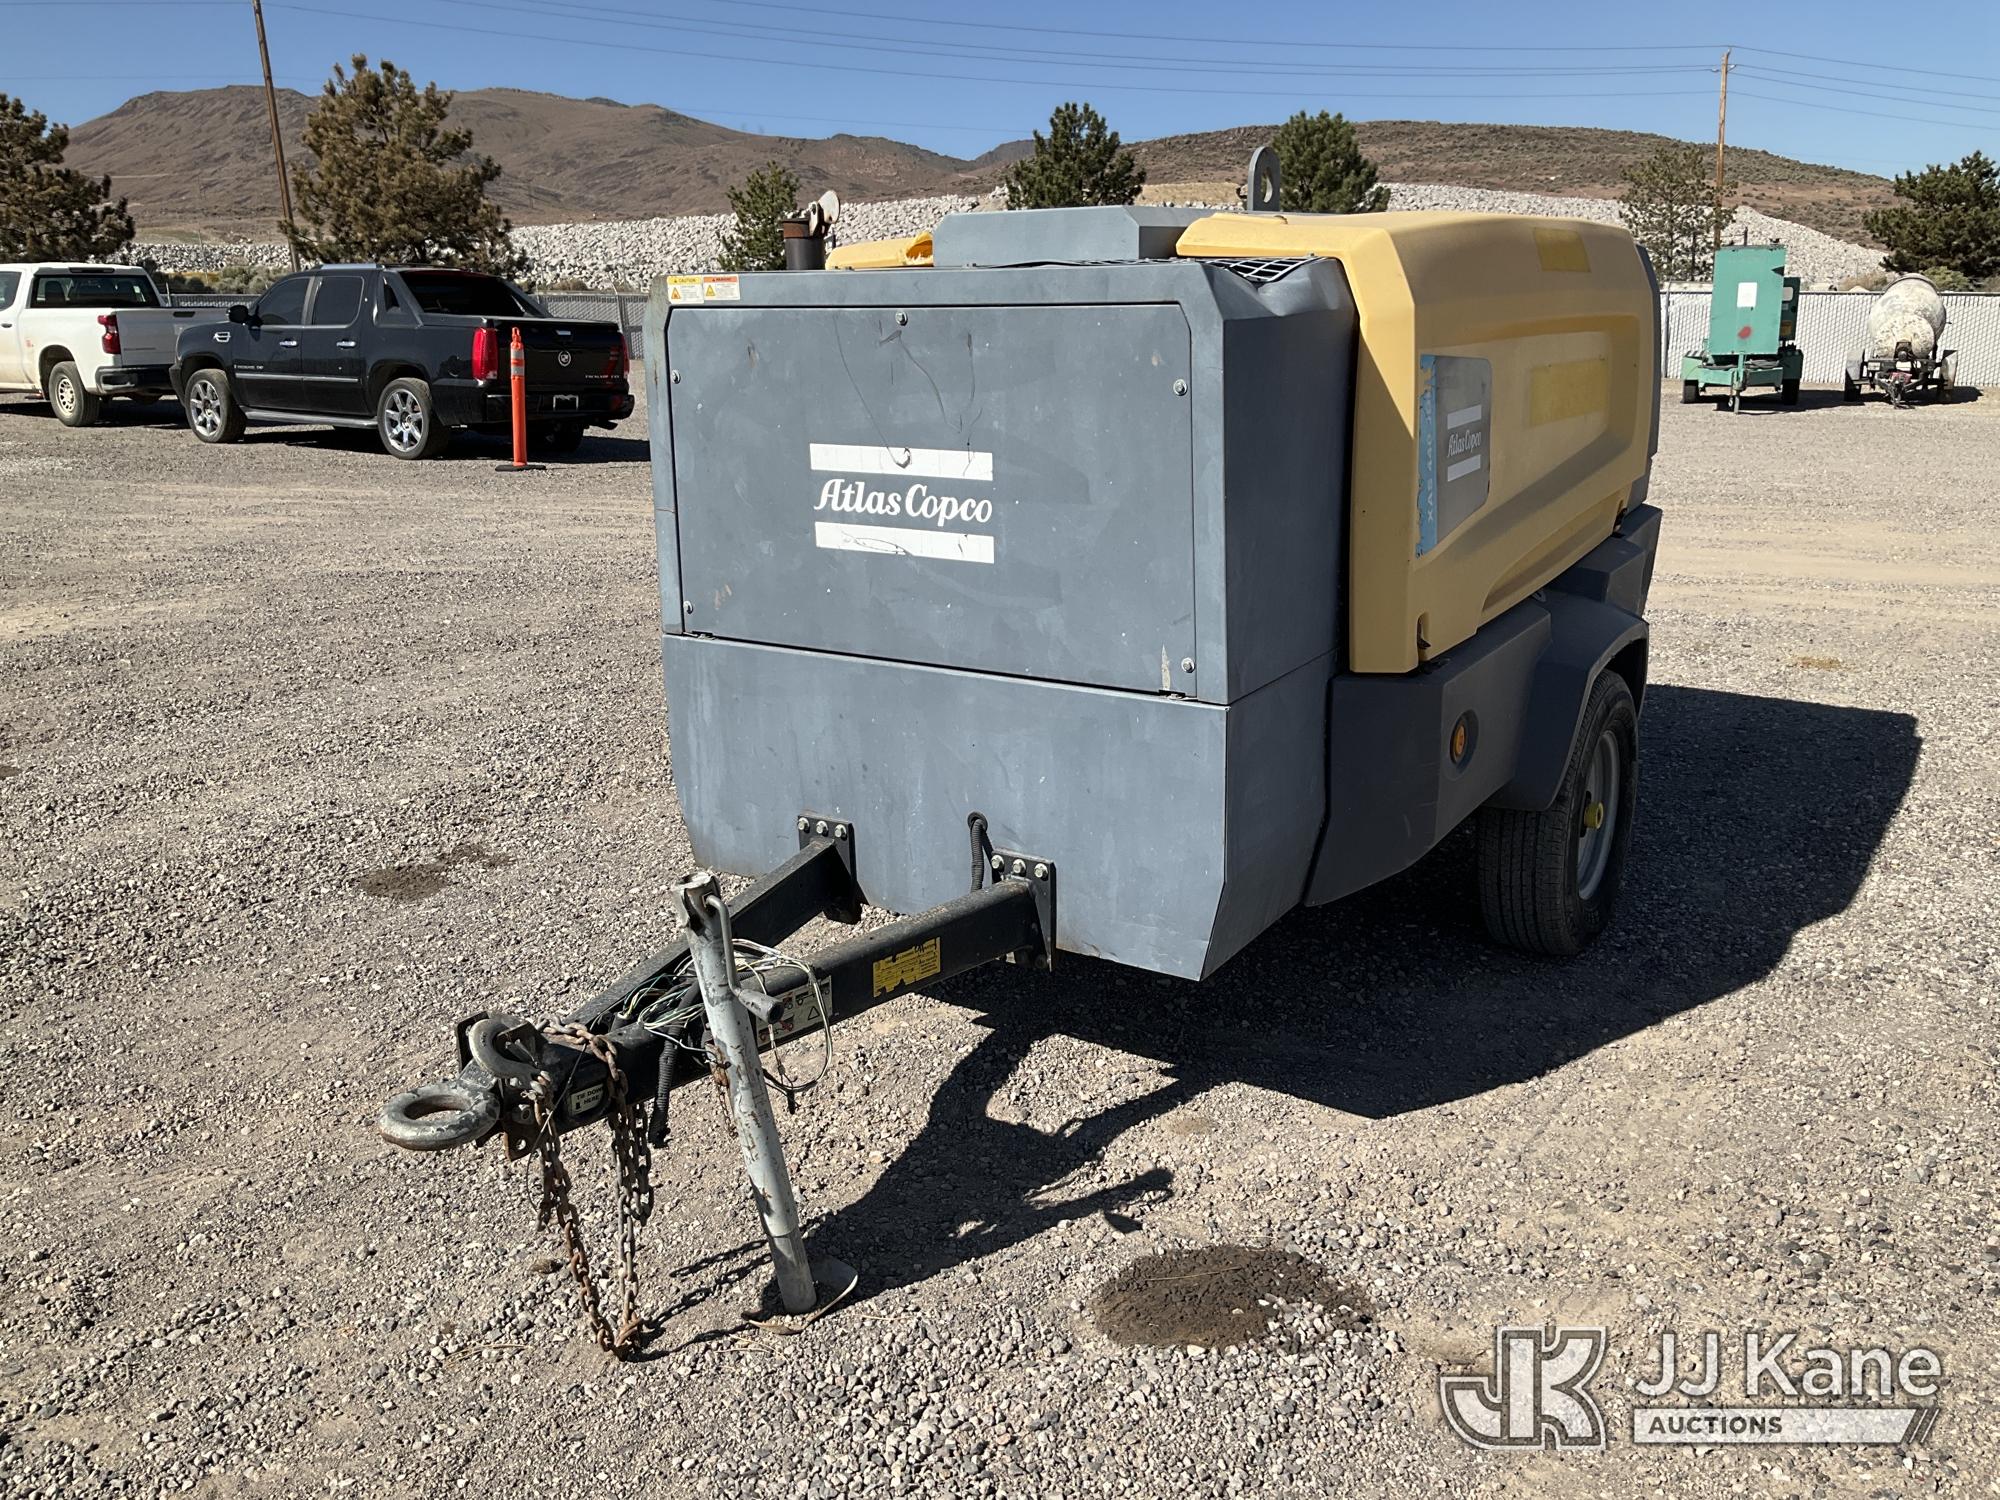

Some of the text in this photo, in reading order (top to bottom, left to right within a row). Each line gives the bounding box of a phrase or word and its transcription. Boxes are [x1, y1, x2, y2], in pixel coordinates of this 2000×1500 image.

[1447, 429, 1482, 458] Atlas Copco
[813, 478, 993, 527] Atlas Copco
